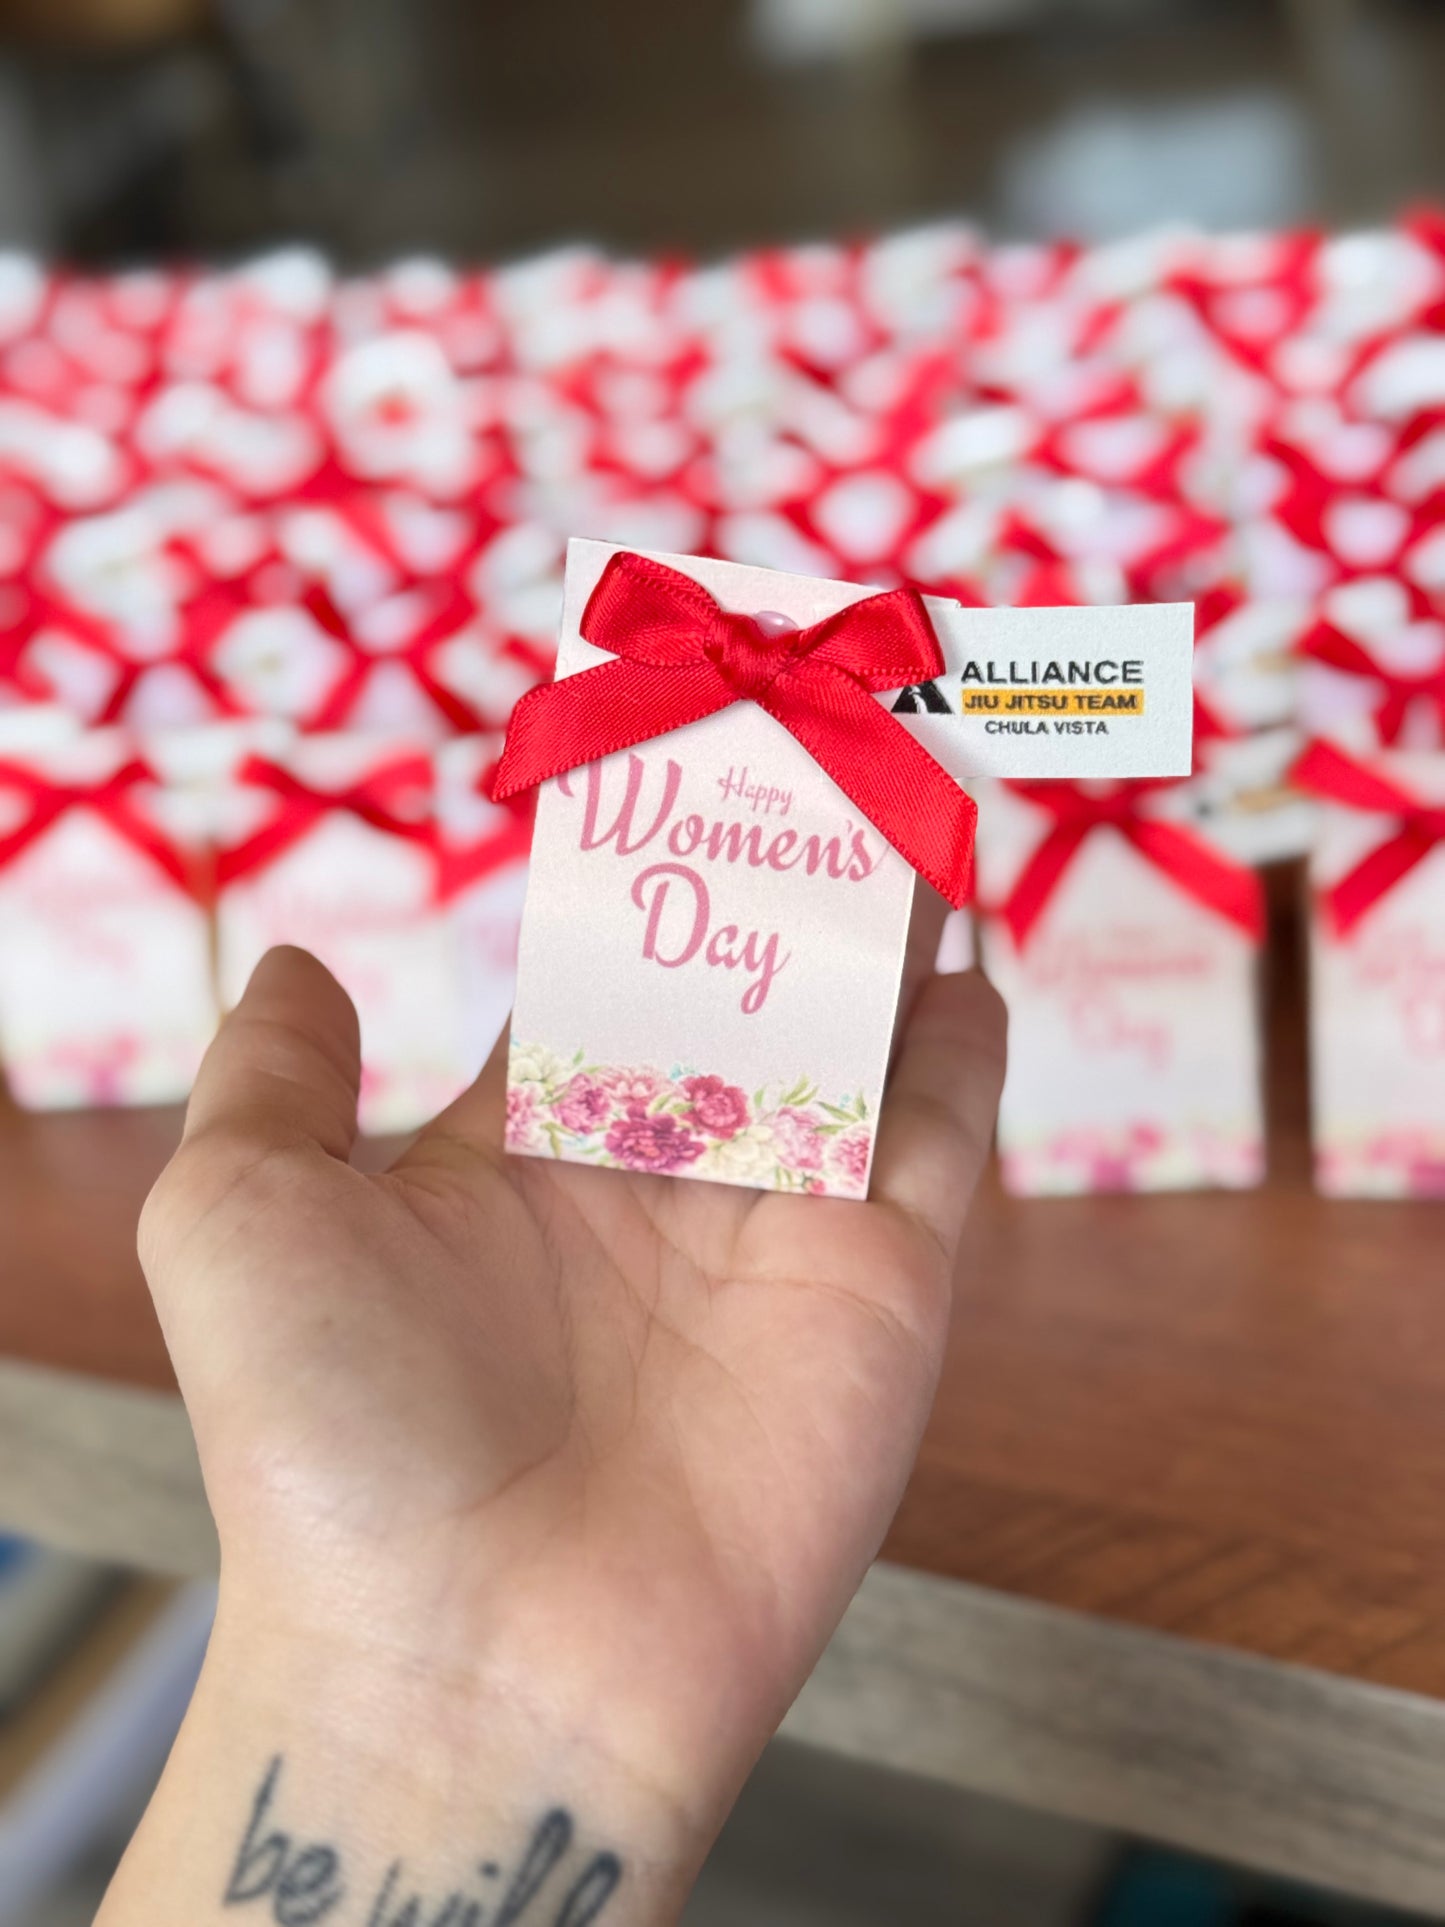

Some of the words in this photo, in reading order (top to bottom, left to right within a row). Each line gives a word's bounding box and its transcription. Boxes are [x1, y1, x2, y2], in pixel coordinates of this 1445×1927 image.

[960, 660, 1144, 684] ALLIANCE
[964, 694, 999, 709] JIU
[1005, 694, 1068, 710] JITSU
[1075, 694, 1137, 710] TEAM
[984, 720, 1049, 735] CHULA
[1054, 720, 1109, 735] VISTA
[716, 765, 793, 817] Happy
[630, 861, 792, 1015] Day
[221, 1752, 343, 1927] be
